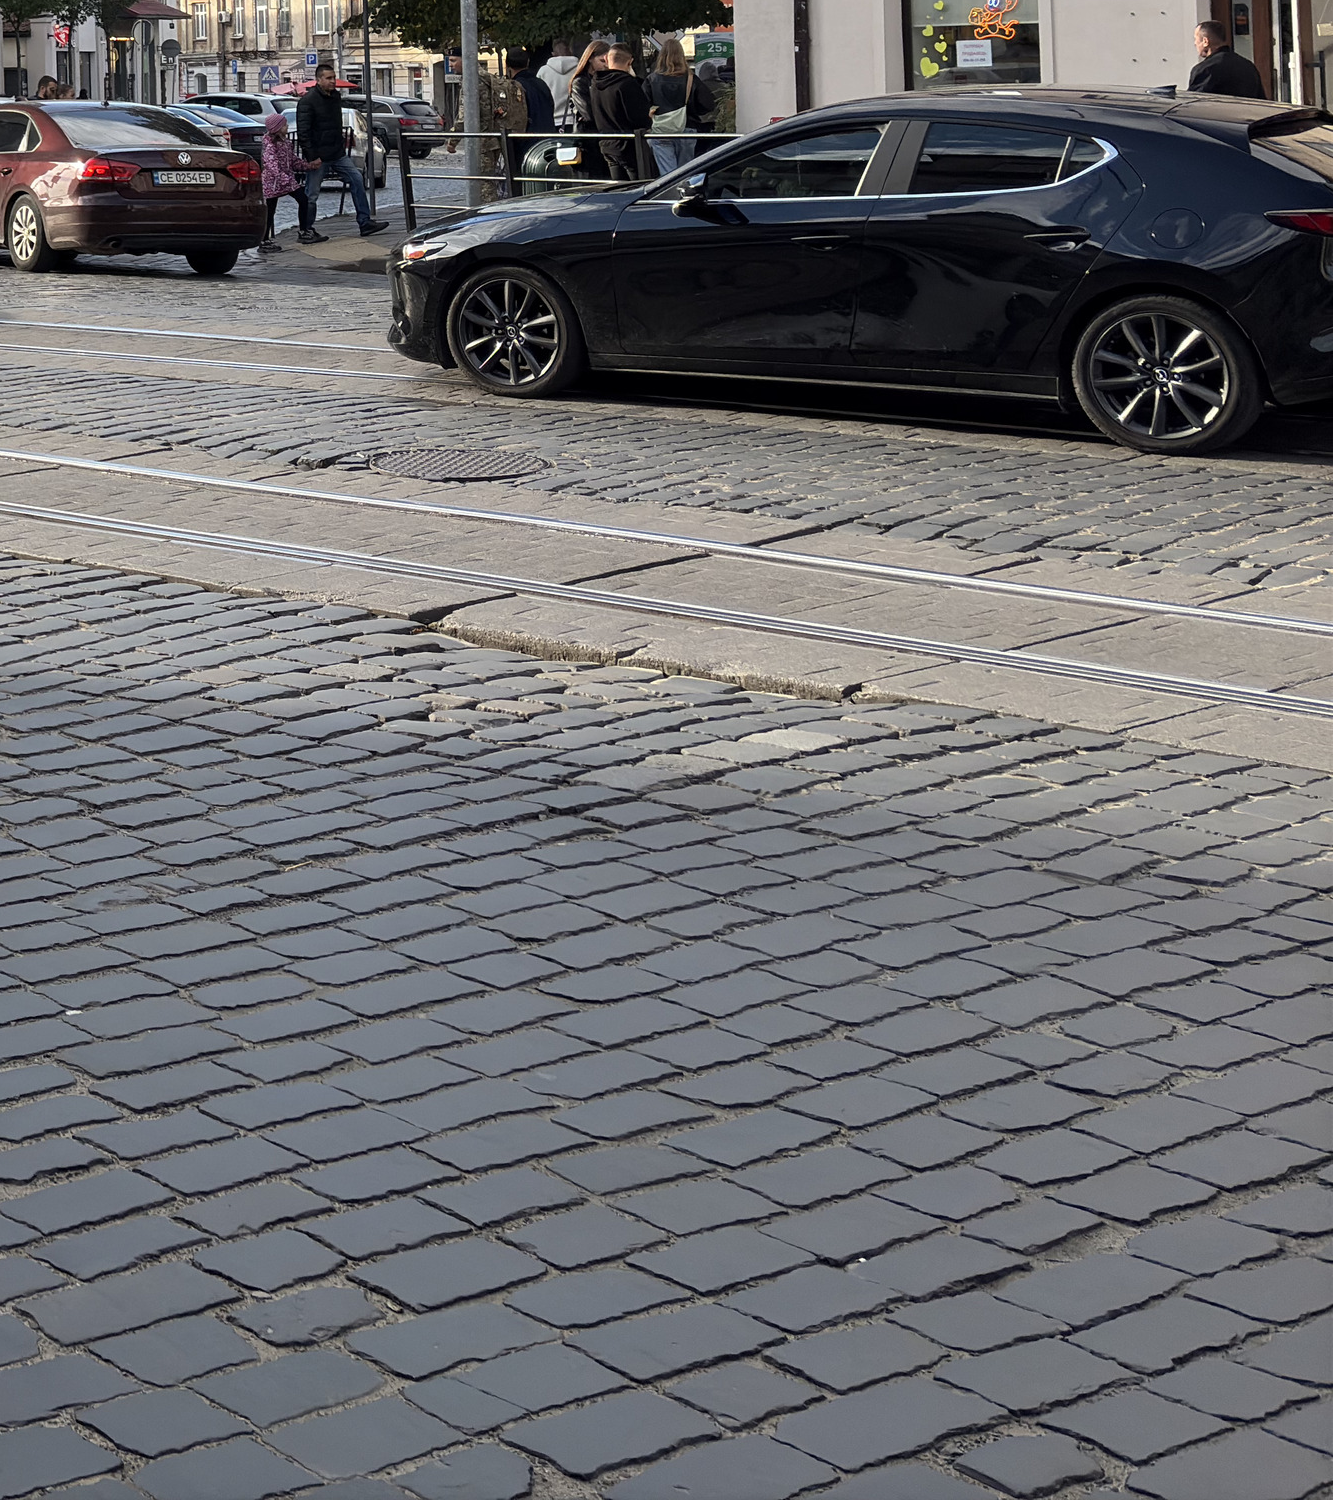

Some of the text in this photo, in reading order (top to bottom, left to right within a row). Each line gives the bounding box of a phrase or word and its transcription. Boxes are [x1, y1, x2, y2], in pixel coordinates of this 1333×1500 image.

[160, 173, 212, 183] CE 0254 EP
